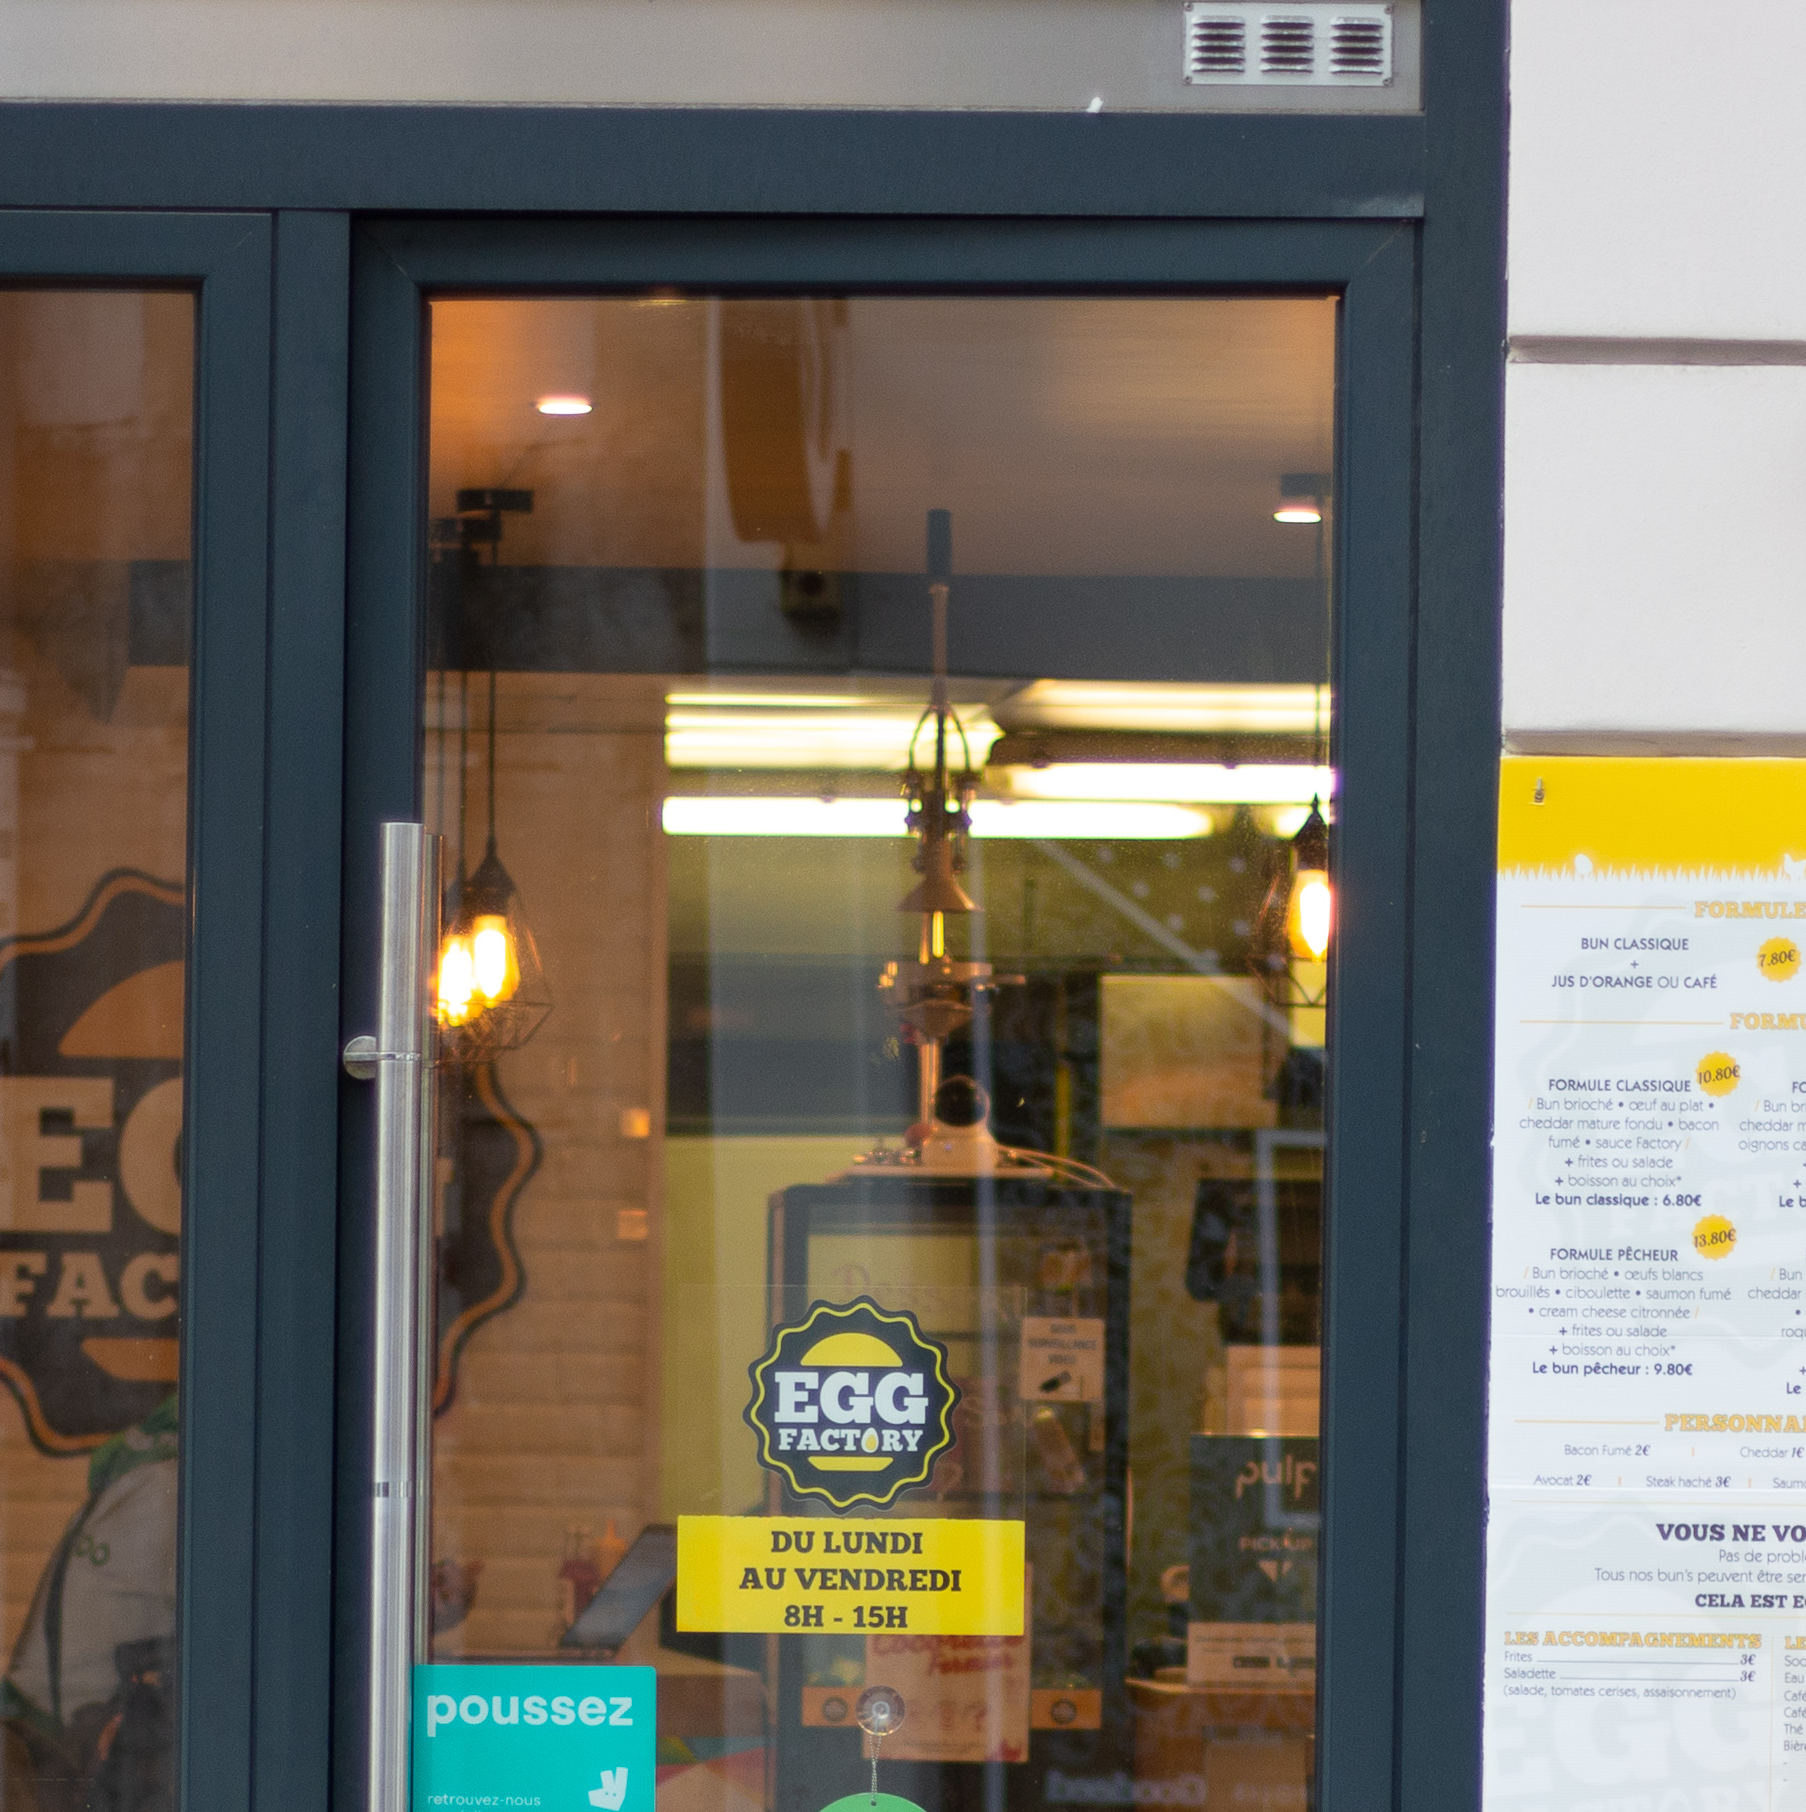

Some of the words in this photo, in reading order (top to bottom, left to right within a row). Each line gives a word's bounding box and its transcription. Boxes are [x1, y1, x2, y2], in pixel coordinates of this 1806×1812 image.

[1582, 938, 1608, 950] BUN
[1614, 938, 1689, 951] CLASSIQUE
[1759, 950, 1796, 967] 7.80€
[1552, 976, 1574, 988] JUS
[1580, 976, 1652, 988] D'ORANGE
[1658, 976, 1678, 988] OU
[1684, 974, 1717, 988] CAFÉ
[1697, 1066, 1742, 1085] 10.80€
[1549, 1079, 1610, 1092] FORMULE
[1617, 1080, 1691, 1093] CLASSIQUE
[1694, 1230, 1737, 1249] 13.80€
[1550, 1249, 1612, 1262] FORMULE
[1619, 1246, 1678, 1262] PÊCHEUR
[774, 1371, 928, 1424] EGG
[1657, 1524, 1725, 1541] VOUS
[1733, 1525, 1765, 1542] NE
[770, 1531, 815, 1553] DU
[823, 1531, 922, 1555] LUNDI
[739, 1568, 786, 1590] AU
[794, 1569, 962, 1592] VENDREDI
[1695, 1594, 1745, 1609] CELA
[1750, 1595, 1788, 1608] EST
[784, 1606, 824, 1628] 8H
[852, 1606, 908, 1629] 15H
[1504, 1631, 1540, 1646] LES
[1543, 1631, 1762, 1649] ACCOMPAGNEMENTS
[427, 1693, 633, 1738] poussez
[427, 1794, 541, 1807] retrouvez-nous
